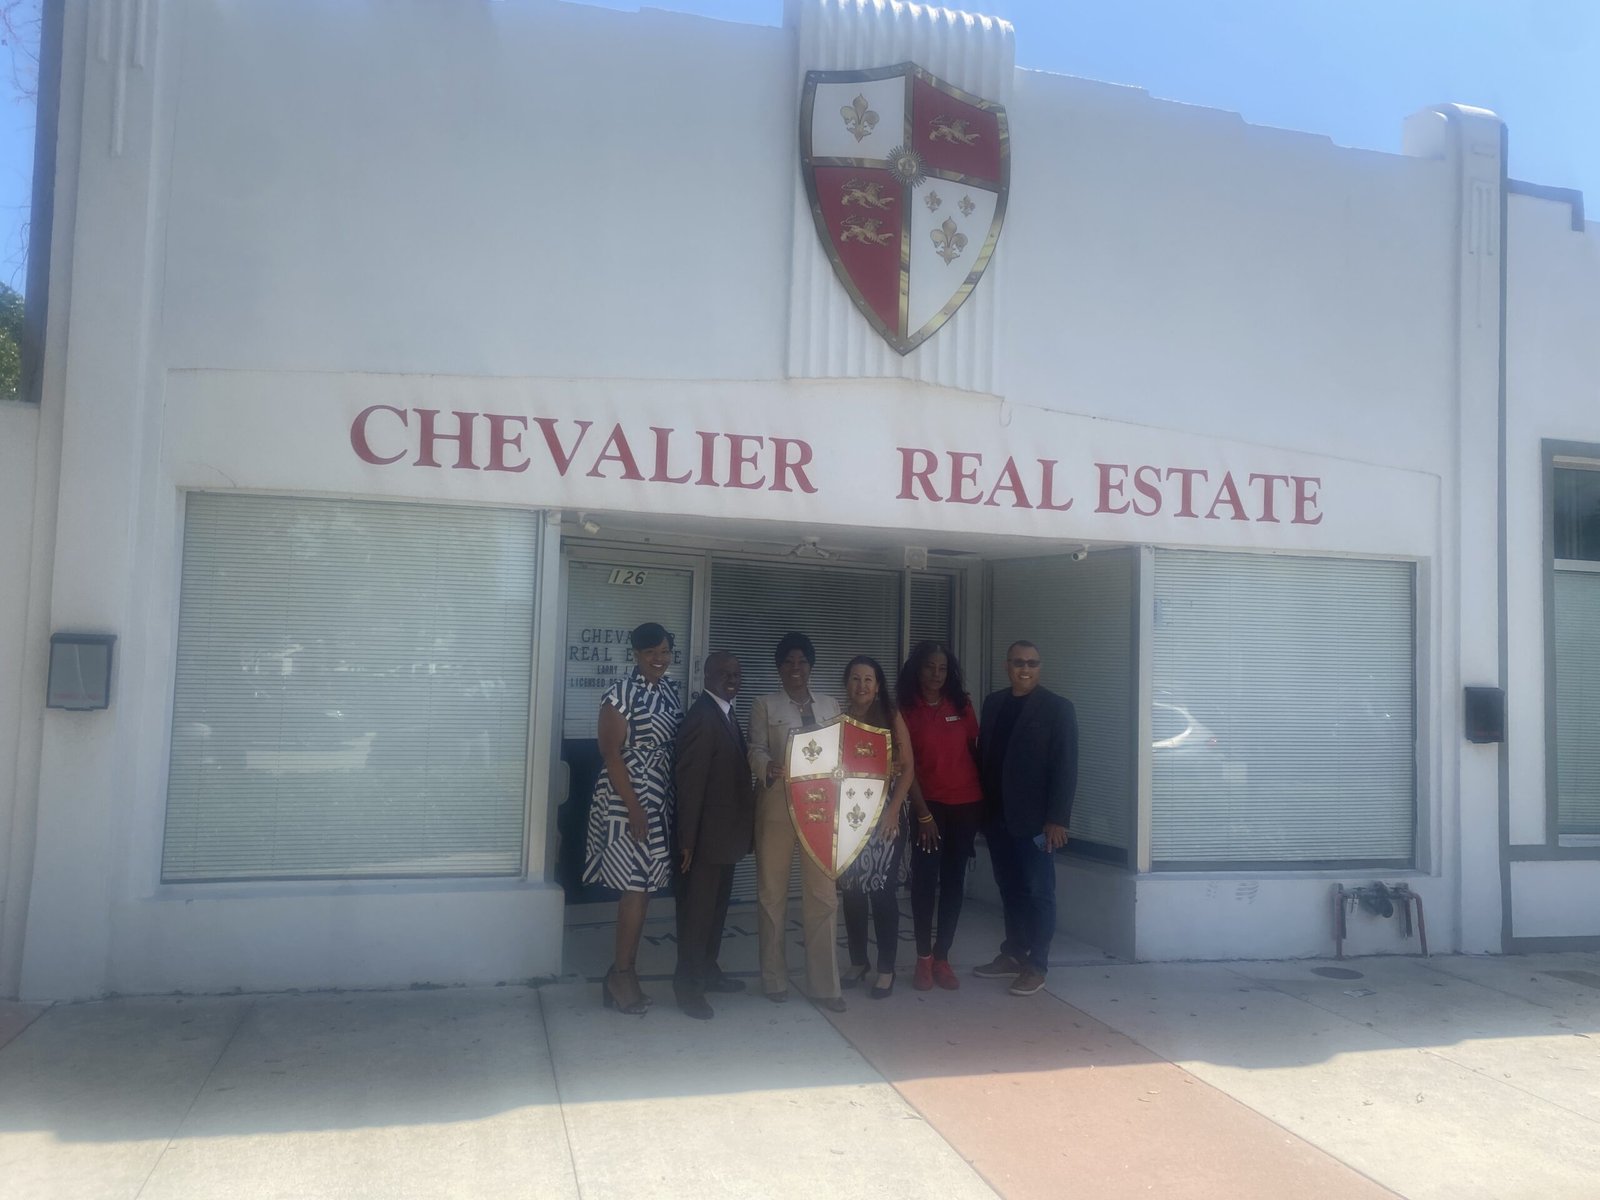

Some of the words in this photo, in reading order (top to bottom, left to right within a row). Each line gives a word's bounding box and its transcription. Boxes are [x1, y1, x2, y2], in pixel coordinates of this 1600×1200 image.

[350, 404, 818, 494] CHEVALIER
[896, 447, 1074, 511] REAL
[1094, 463, 1323, 525] ESTATE
[612, 570, 646, 585] 126
[581, 628, 676, 647] CHEVAR
[569, 646, 612, 662] REAL
